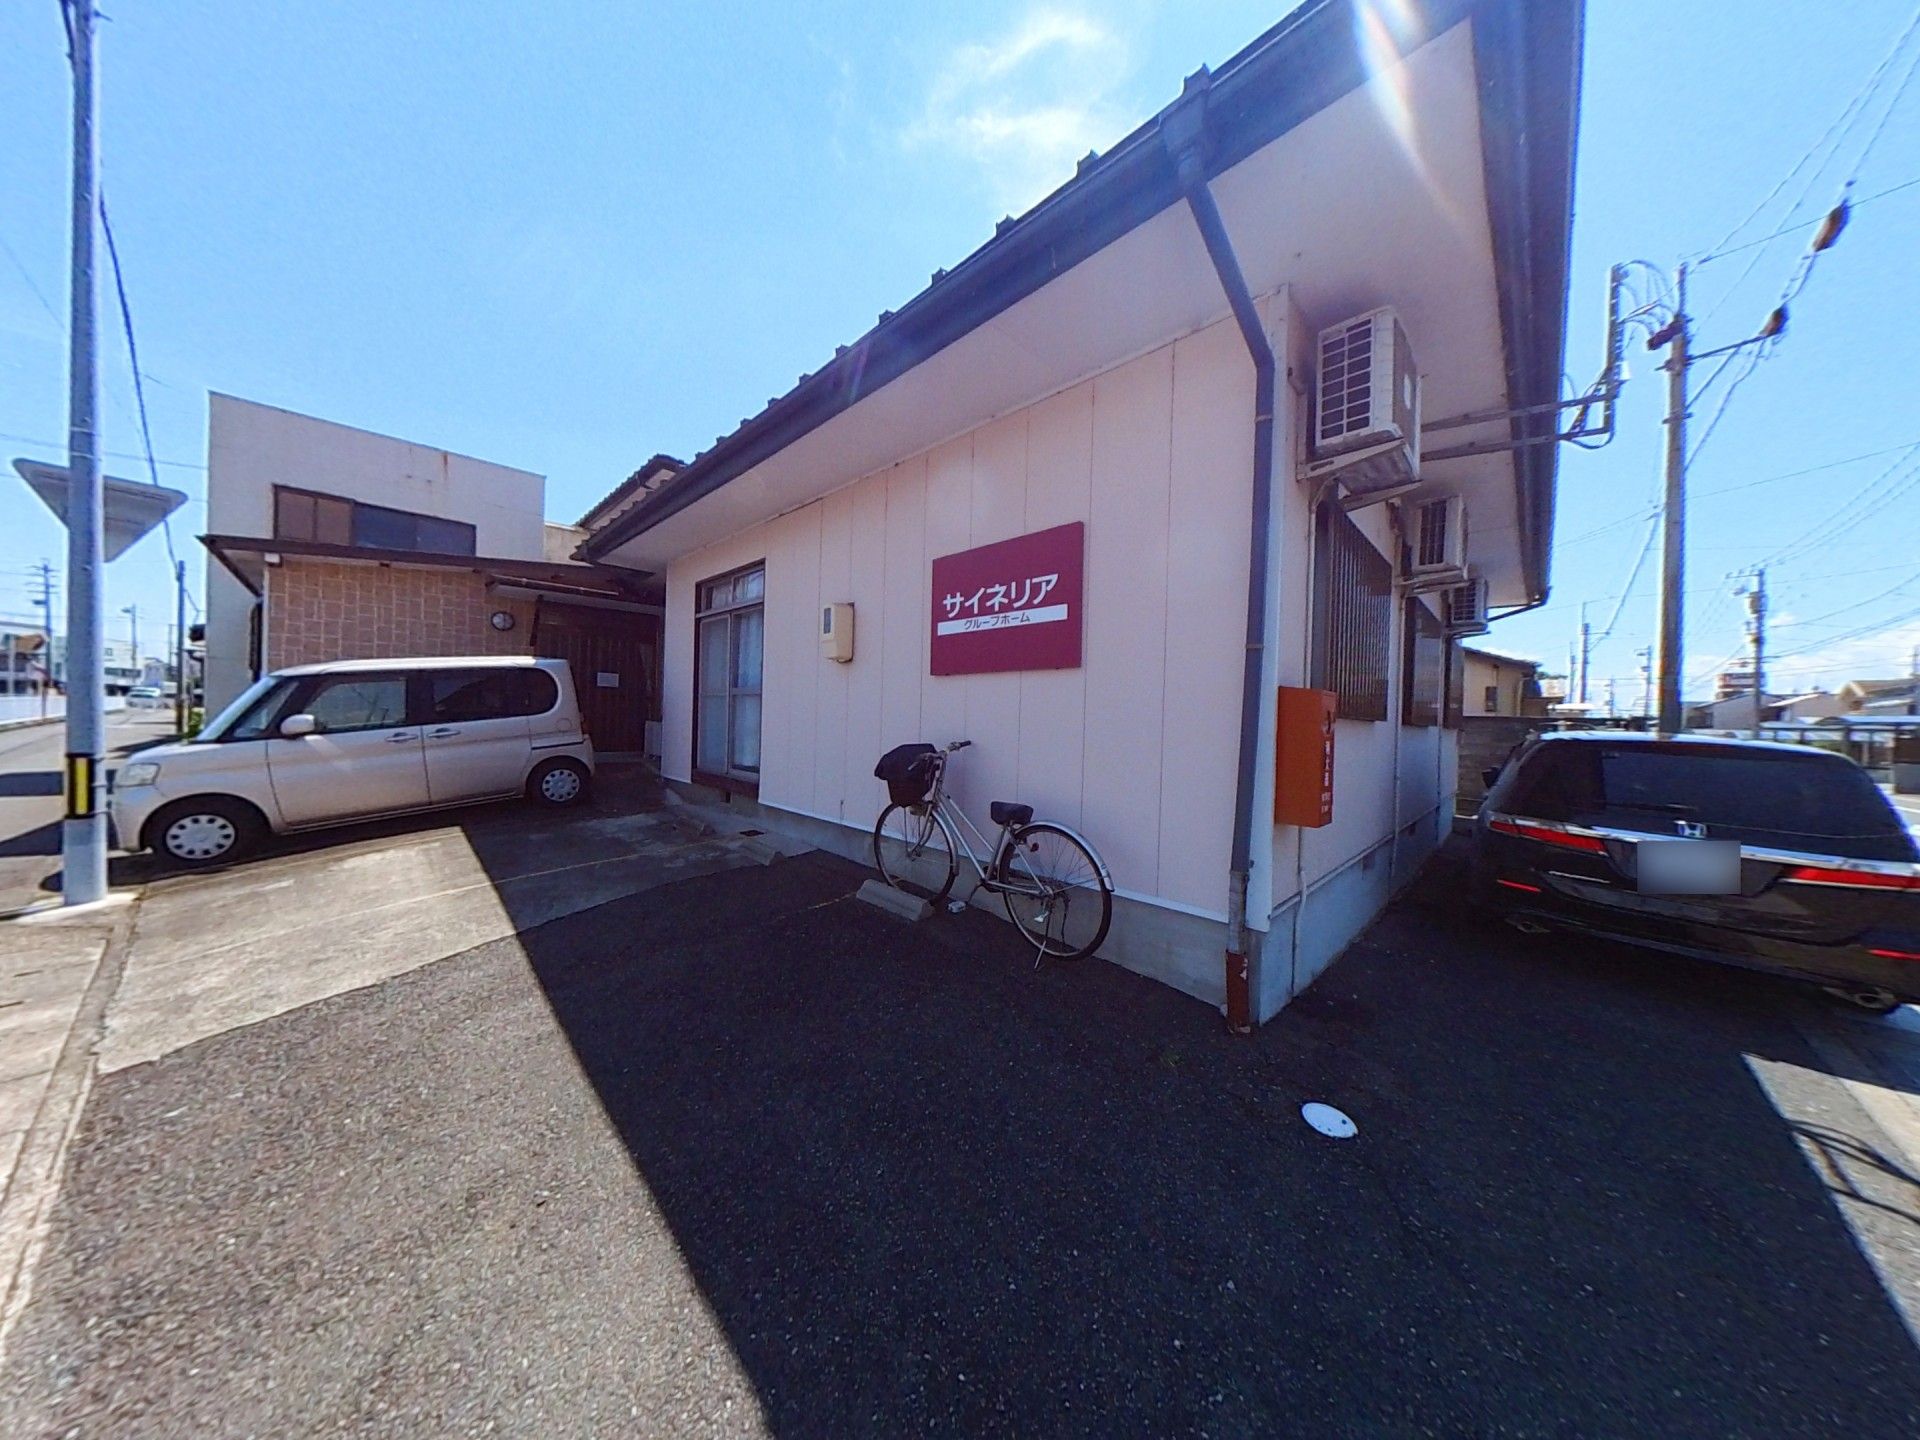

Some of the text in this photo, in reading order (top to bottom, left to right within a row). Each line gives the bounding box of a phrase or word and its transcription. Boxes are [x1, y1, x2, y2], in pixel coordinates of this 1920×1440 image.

[943, 574, 1058, 618] サイネリア
[964, 612, 1030, 630] グループホーム
